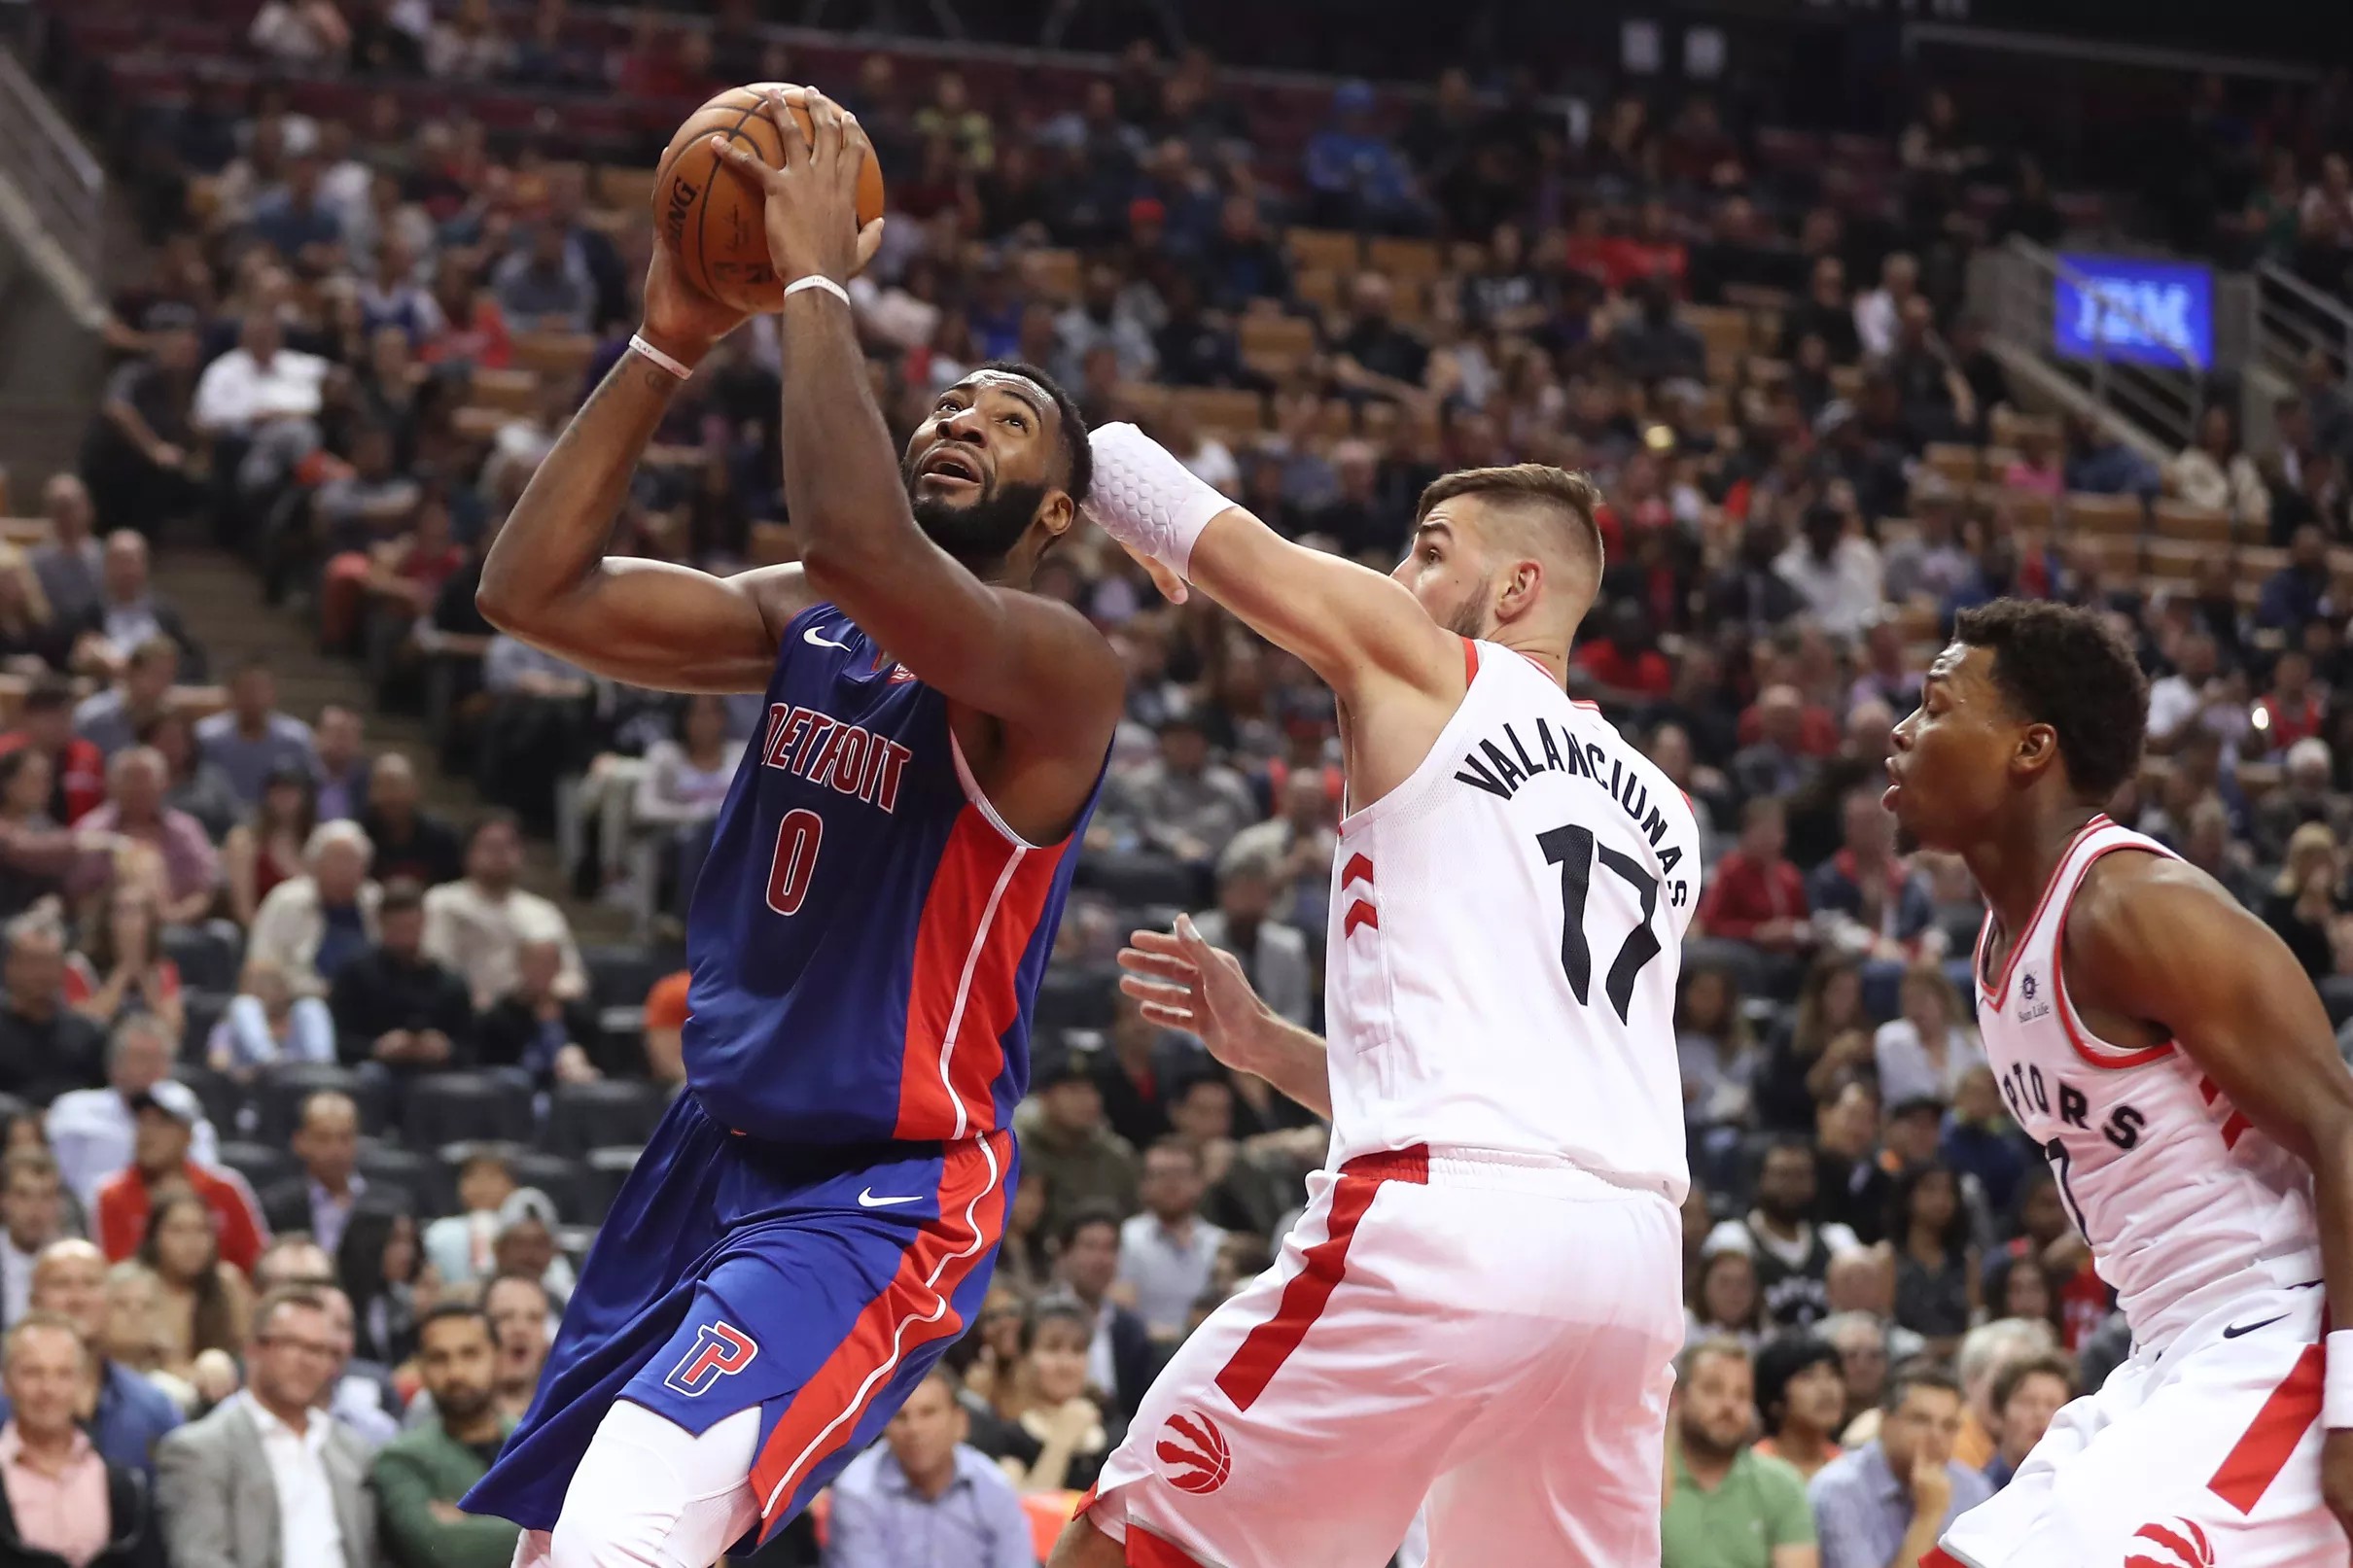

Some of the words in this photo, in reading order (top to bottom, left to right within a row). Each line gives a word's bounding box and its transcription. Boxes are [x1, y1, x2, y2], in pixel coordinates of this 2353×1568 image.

[761, 702, 913, 815] DETROIT
[1454, 717, 1687, 907] VALANCIUNAS
[766, 808, 824, 917] 0
[1535, 823, 1662, 1027] 17
